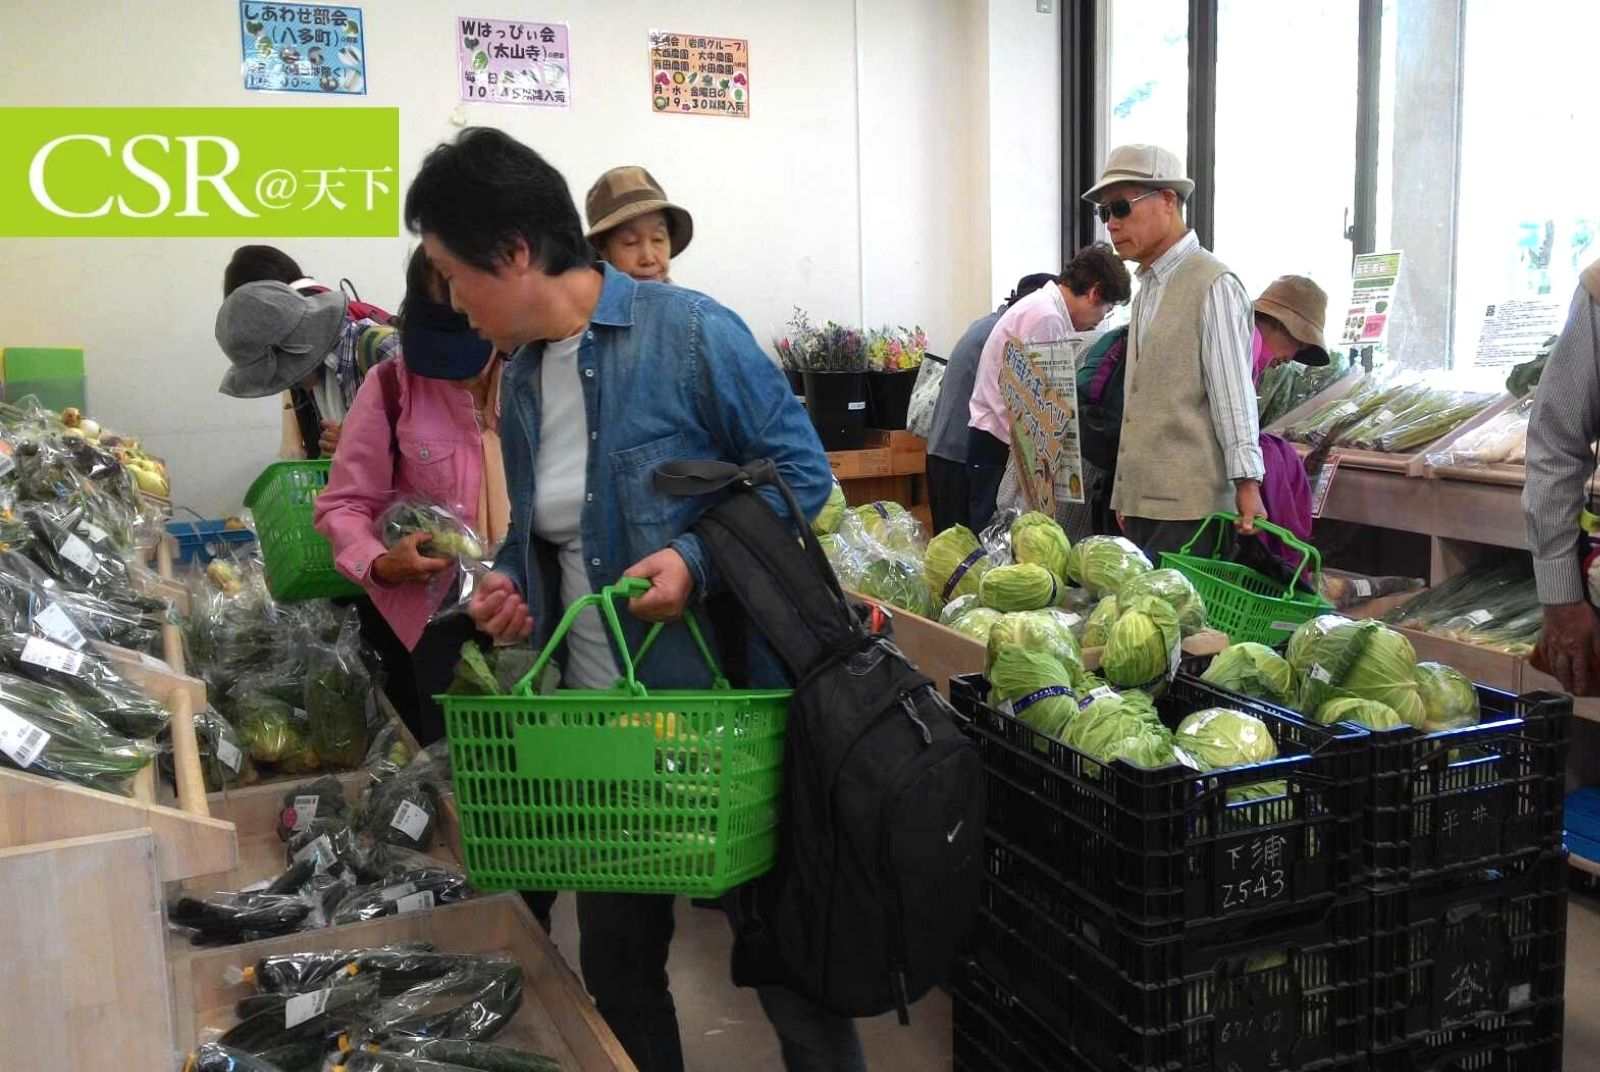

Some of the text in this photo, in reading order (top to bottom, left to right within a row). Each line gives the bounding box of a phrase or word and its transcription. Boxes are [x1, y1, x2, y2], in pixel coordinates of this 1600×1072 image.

[244, 4, 348, 27] しあわせ部会
[271, 25, 339, 48] （八多町）
